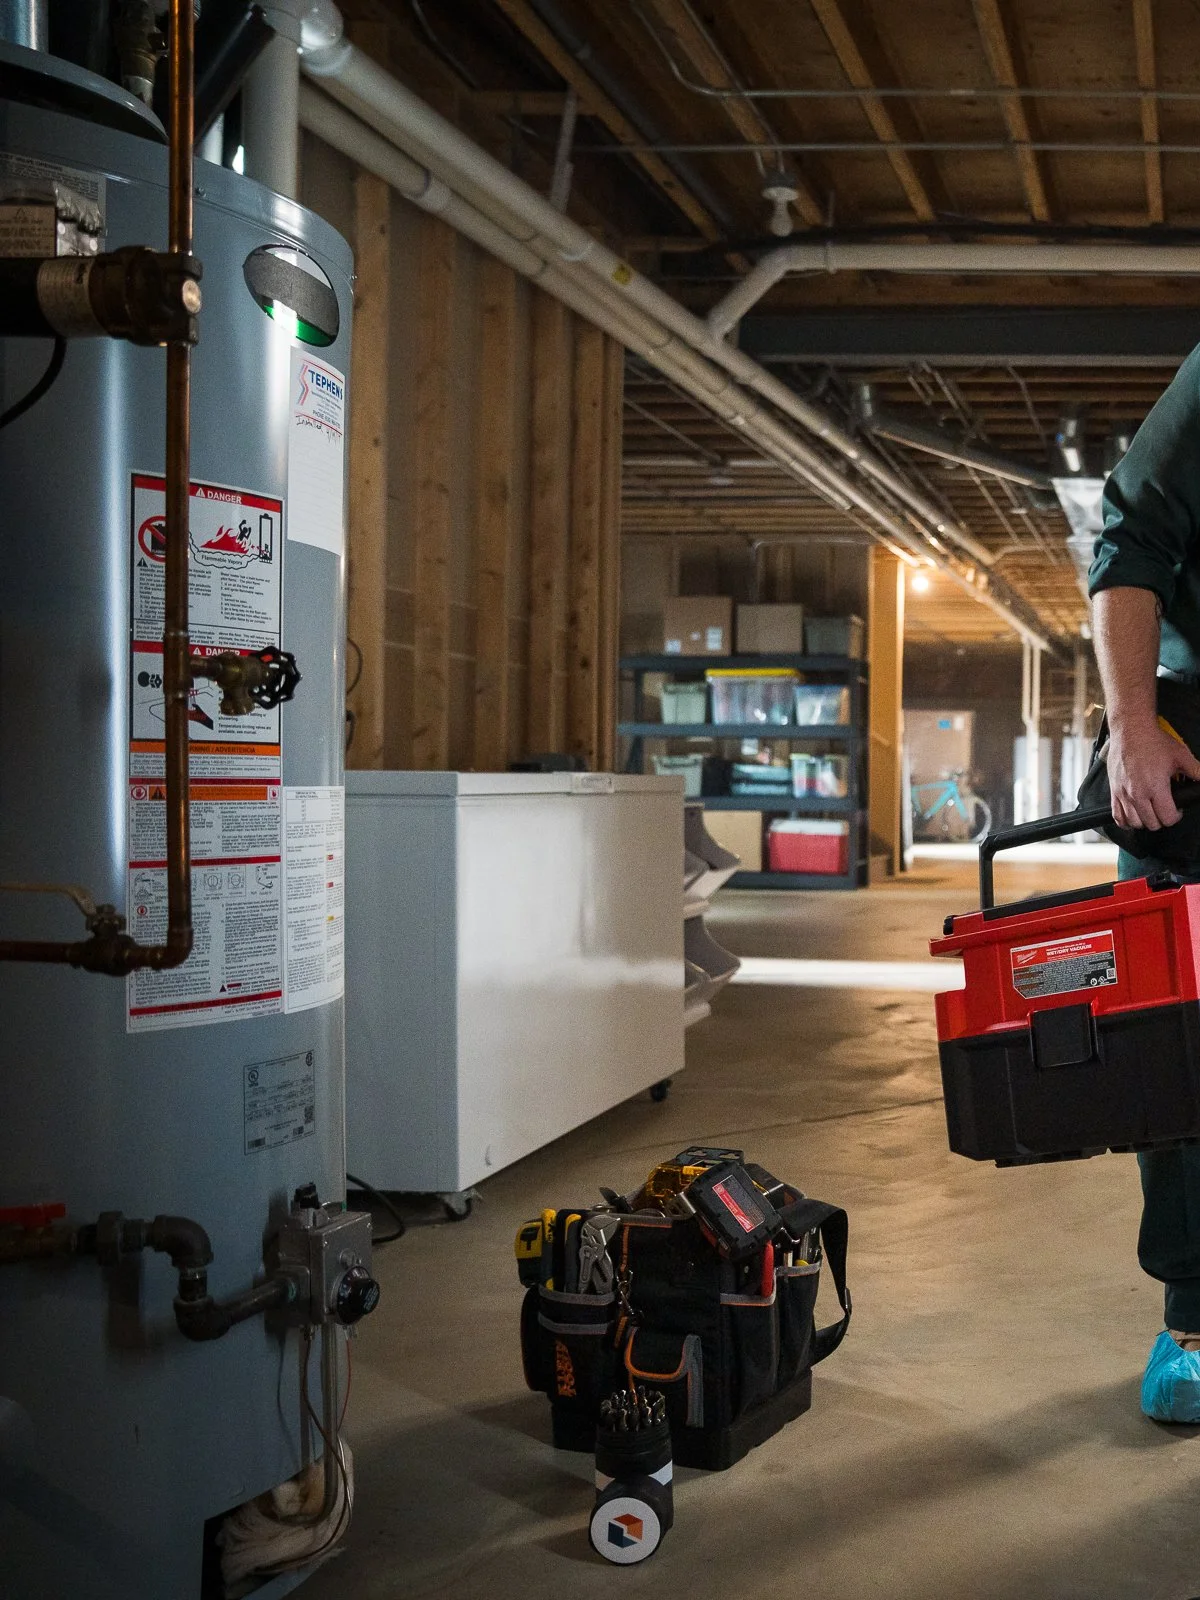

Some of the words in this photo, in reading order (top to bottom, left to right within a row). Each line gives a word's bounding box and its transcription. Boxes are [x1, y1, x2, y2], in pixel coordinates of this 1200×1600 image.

[207, 490, 242, 504] DANGER
[201, 554, 228, 563] Flammable
[227, 557, 243, 565] Vapors
[1046, 947, 1069, 957] WET/DRY
[1069, 943, 1093, 952] VACUUM
